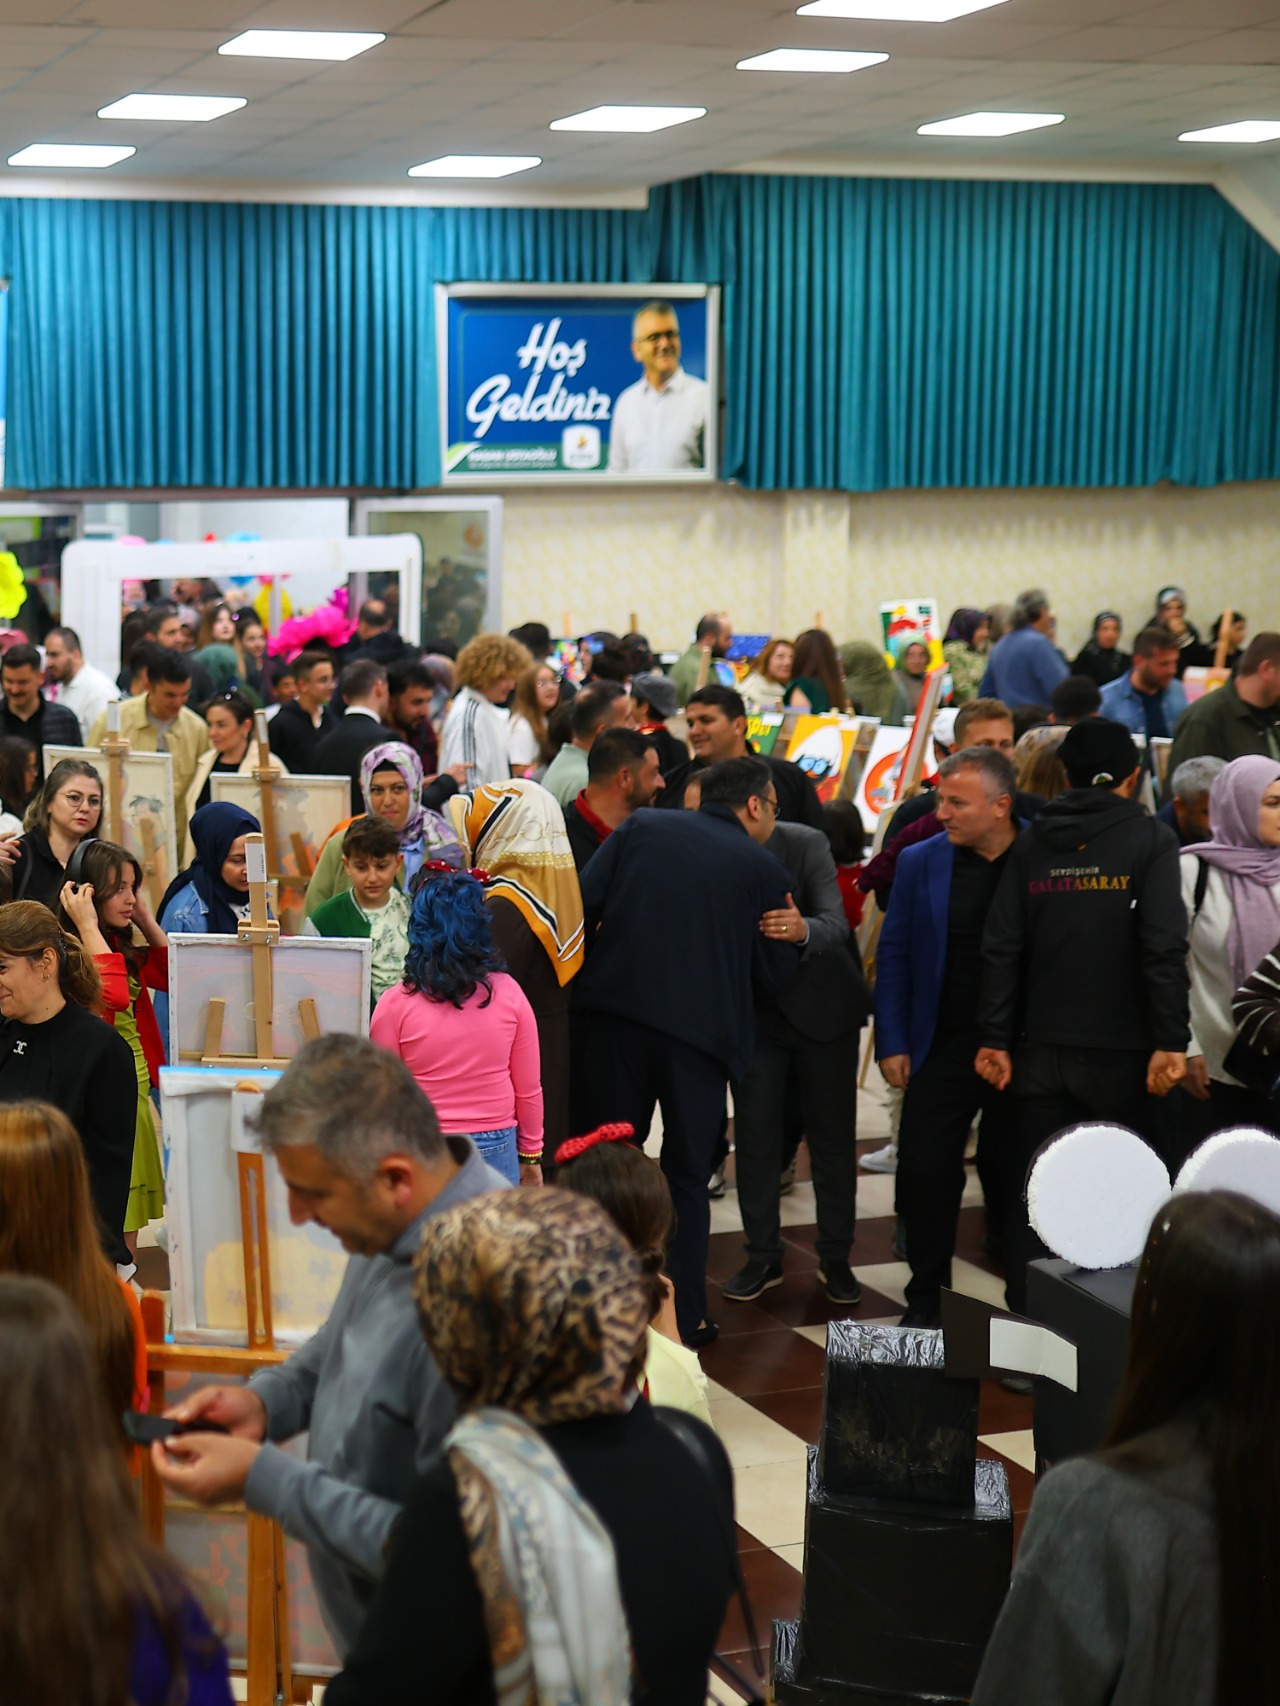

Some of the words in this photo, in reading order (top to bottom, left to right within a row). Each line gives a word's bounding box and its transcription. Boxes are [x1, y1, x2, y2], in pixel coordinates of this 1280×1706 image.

[517, 317, 587, 377] Hoş
[466, 372, 612, 438] Geldiniz
[1028, 875, 1131, 894] GALATASARAY
